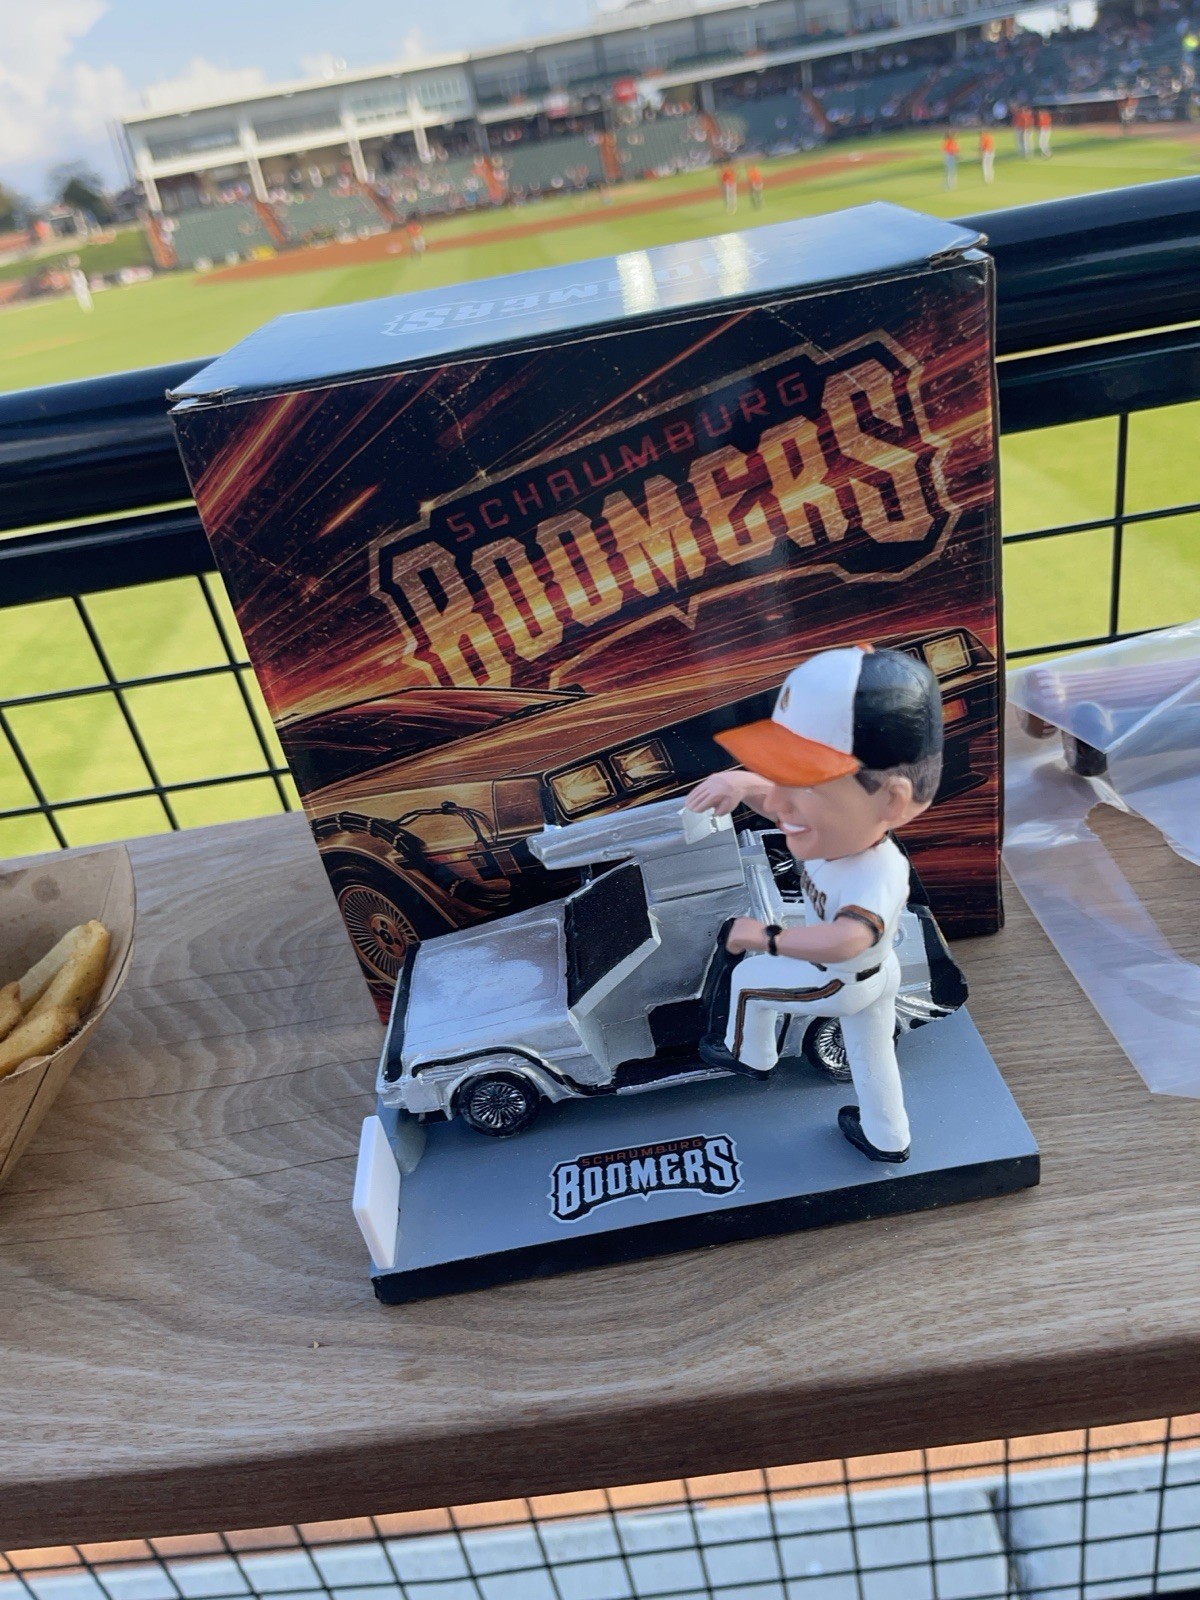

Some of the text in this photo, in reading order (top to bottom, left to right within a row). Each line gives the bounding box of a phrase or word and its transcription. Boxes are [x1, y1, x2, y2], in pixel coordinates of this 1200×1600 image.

[446, 371, 810, 543] SCHAUMBURG
[392, 358, 935, 687] BOOMERS
[557, 1138, 737, 1216] BOOMERS
[581, 1138, 703, 1167] SCHAUMBURG
